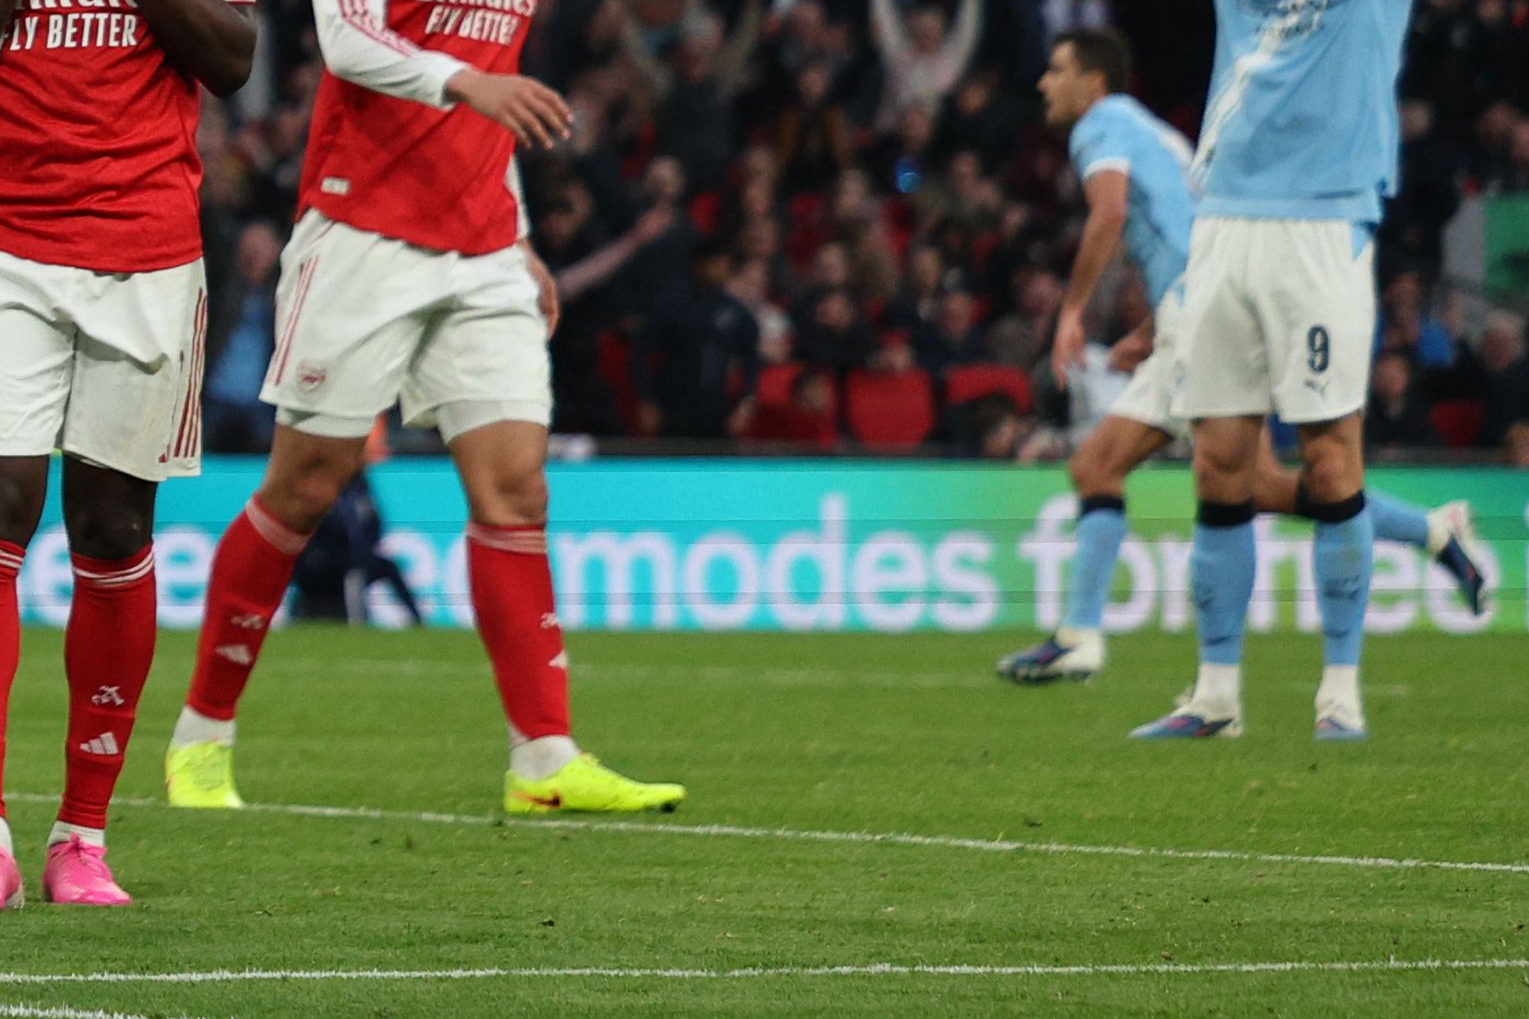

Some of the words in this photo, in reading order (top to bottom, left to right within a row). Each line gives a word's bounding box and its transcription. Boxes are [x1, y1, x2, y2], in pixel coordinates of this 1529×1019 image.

[46, 12, 138, 50] BETTER
[1307, 324, 1331, 374] 9
[554, 492, 1000, 632] modes
